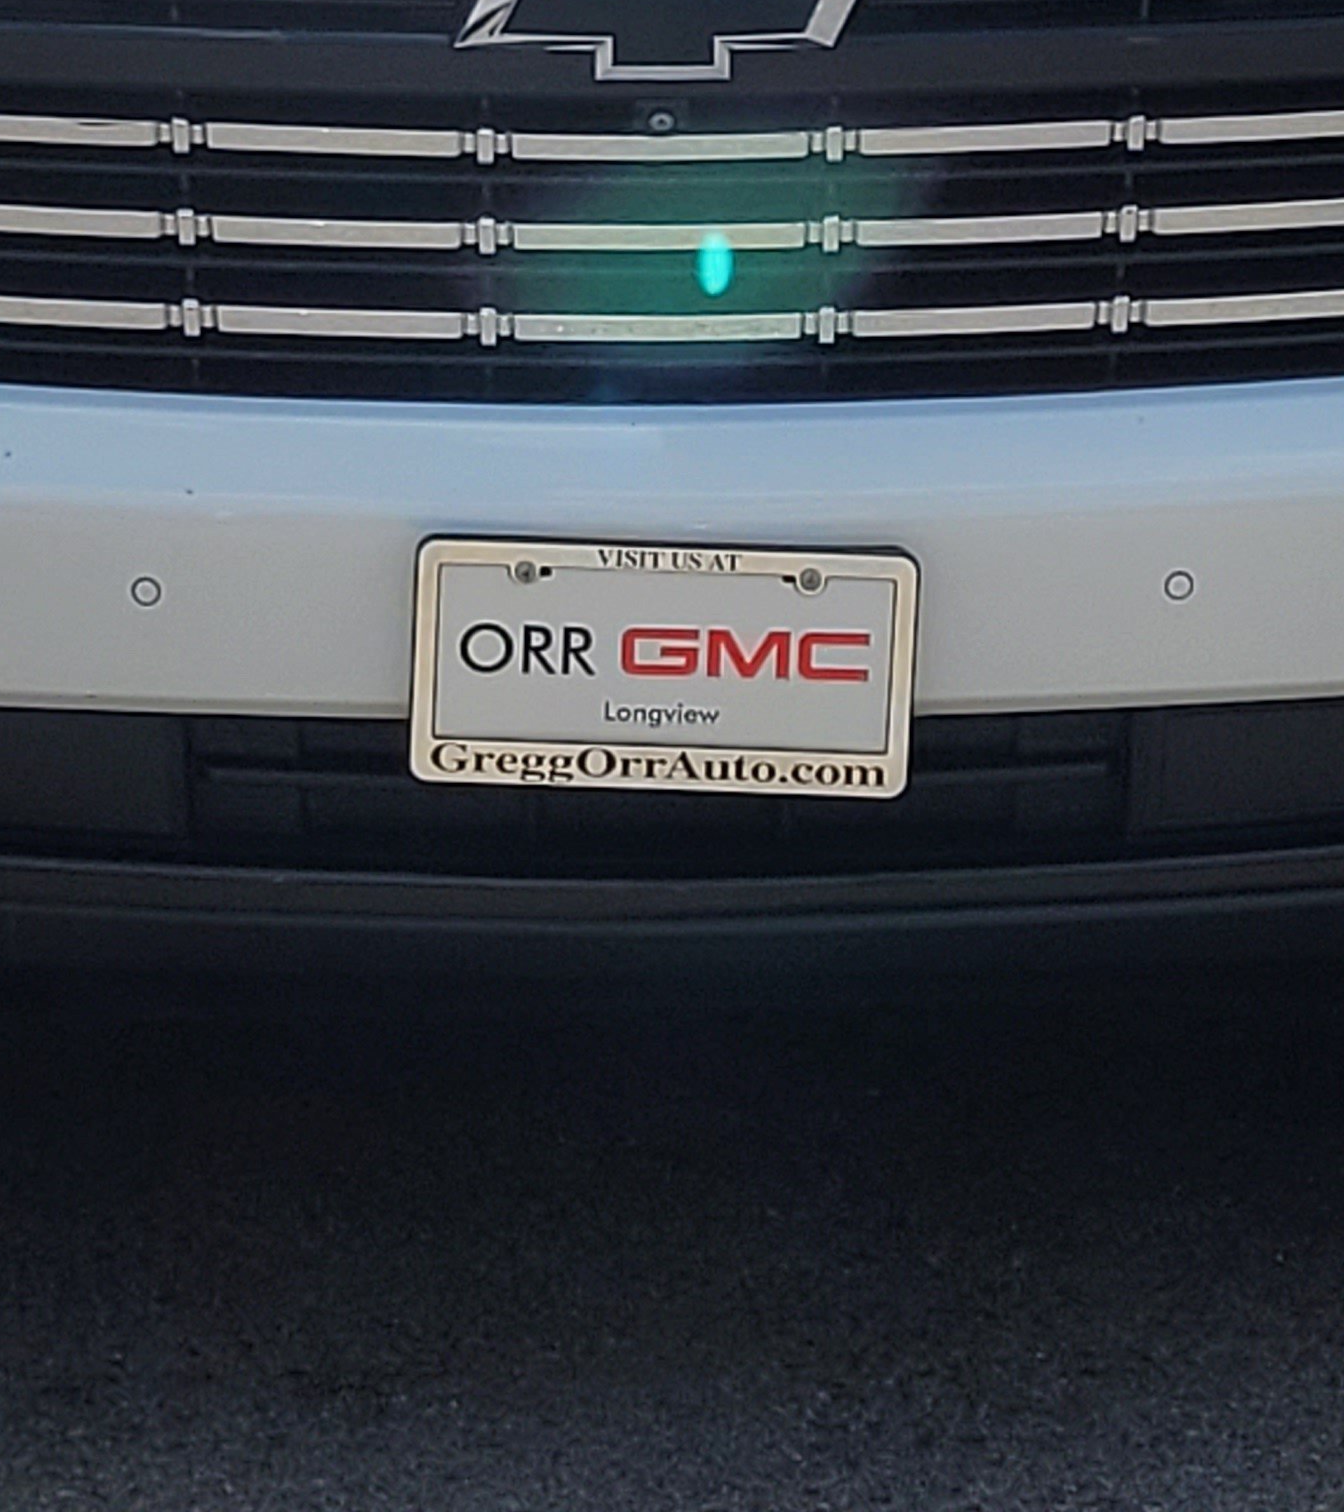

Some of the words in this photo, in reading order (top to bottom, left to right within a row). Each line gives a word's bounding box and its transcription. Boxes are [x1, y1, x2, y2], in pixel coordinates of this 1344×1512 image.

[598, 548, 667, 569] VISIT
[672, 551, 706, 571] US
[708, 552, 744, 573] AT
[459, 622, 596, 676] ORR
[620, 626, 871, 682] GMC
[604, 699, 721, 728] Longview
[431, 741, 887, 787] GreggOrrAuto.com
